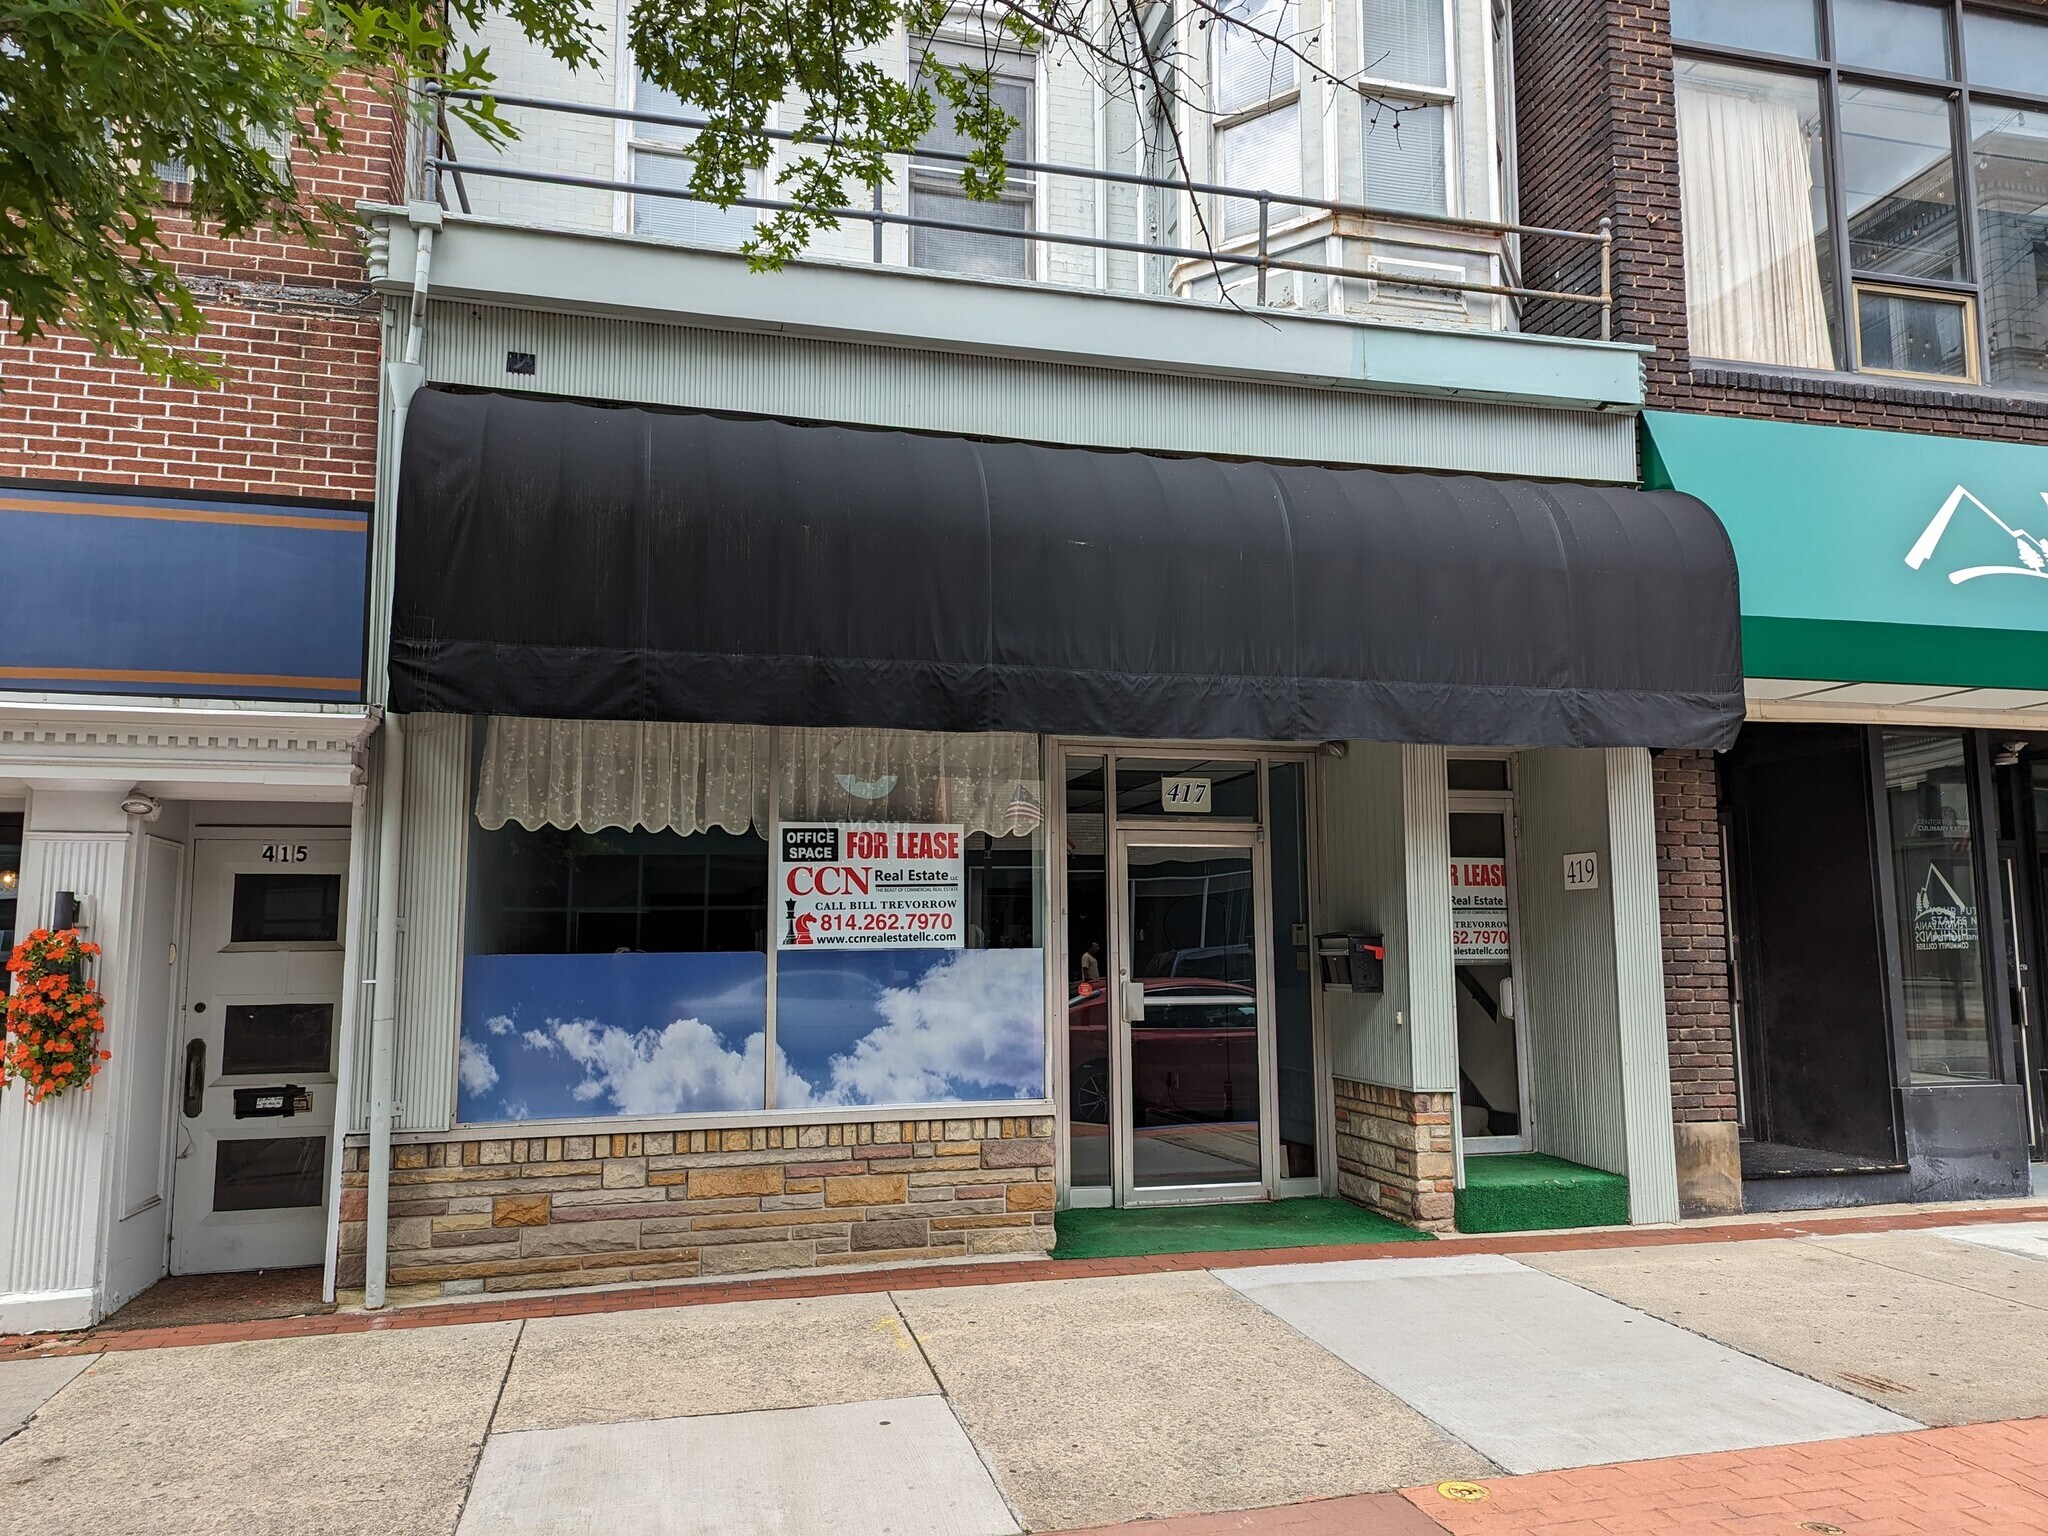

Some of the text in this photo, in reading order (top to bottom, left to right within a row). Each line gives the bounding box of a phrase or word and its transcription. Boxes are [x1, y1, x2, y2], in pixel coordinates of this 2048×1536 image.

[1165, 782, 1208, 803] 417
[786, 832, 835, 844] OFFICE
[846, 831, 889, 860] FOR
[896, 832, 959, 859] LEASE
[262, 845, 308, 862] 415
[789, 847, 832, 859] SPACE
[1567, 858, 1595, 883] 419
[786, 866, 873, 896] CCN
[875, 870, 904, 881] Real
[908, 869, 949, 881] Estate
[815, 900, 957, 911] CALL BILL TREVORROW
[1474, 895, 1504, 905] Estate
[820, 913, 953, 931] 814.262.7970
[816, 932, 957, 944] www.ccnrealestatellc.com
